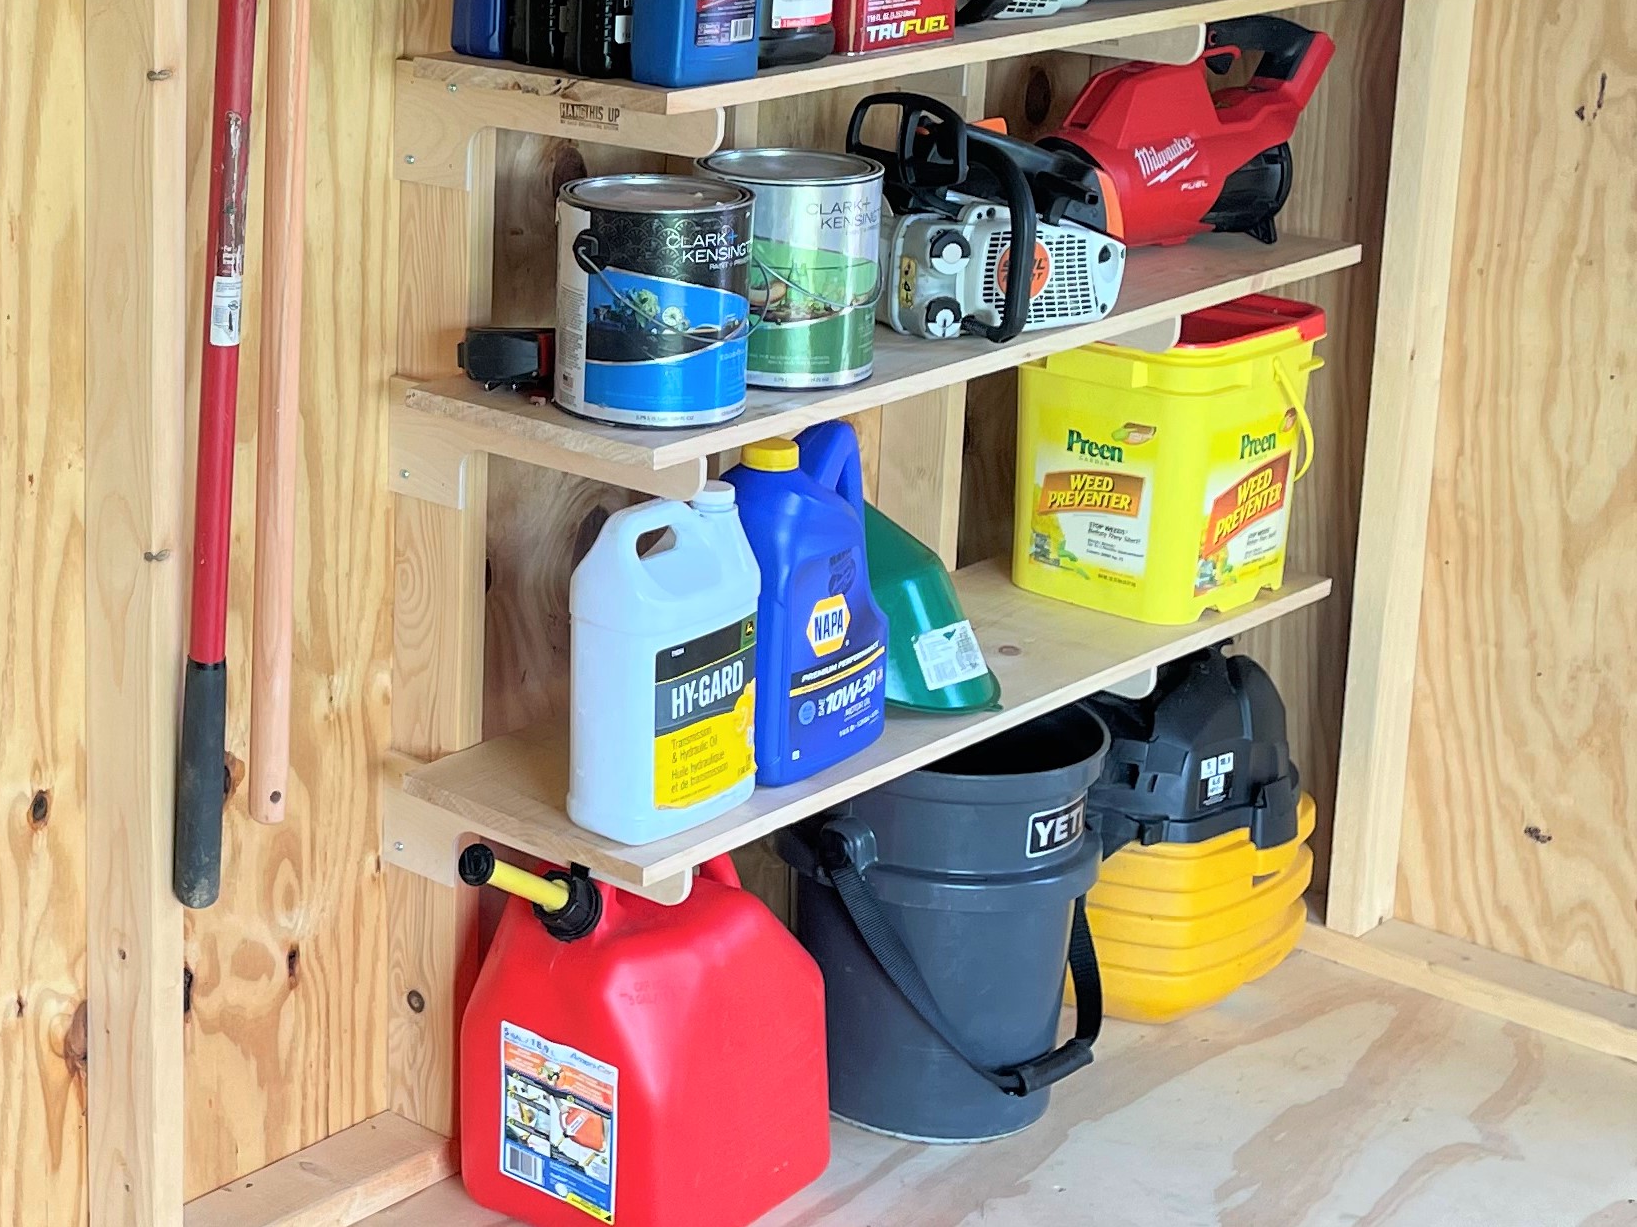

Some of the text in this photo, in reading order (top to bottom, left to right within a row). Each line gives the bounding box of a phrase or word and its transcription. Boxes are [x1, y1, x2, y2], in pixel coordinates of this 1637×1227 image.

[867, 15, 950, 43] TRUFUEL
[608, 107, 620, 122] UP
[1134, 136, 1195, 180] Milwaukee
[1180, 180, 1208, 191] FUEL
[682, 239, 753, 263] KENSINGT
[1067, 429, 1123, 463] Preen
[1240, 432, 1276, 459] Preen
[1070, 474, 1114, 492] WEED
[1237, 467, 1273, 506] WEED
[1048, 491, 1132, 511] PREVENTER
[1213, 482, 1283, 546] PREVENTER
[814, 609, 843, 642] NAPA
[802, 640, 880, 683] PREMIUM PERFORMANCE
[671, 660, 744, 720] HY-GARD
[825, 669, 876, 715] 10W-30
[671, 726, 713, 750] Transmission
[671, 734, 718, 763] & Hydraulic Oil
[671, 766, 688, 780] Huile
[671, 783, 678, 793] et
[680, 780, 688, 790] de
[1034, 802, 1084, 847] YETI
